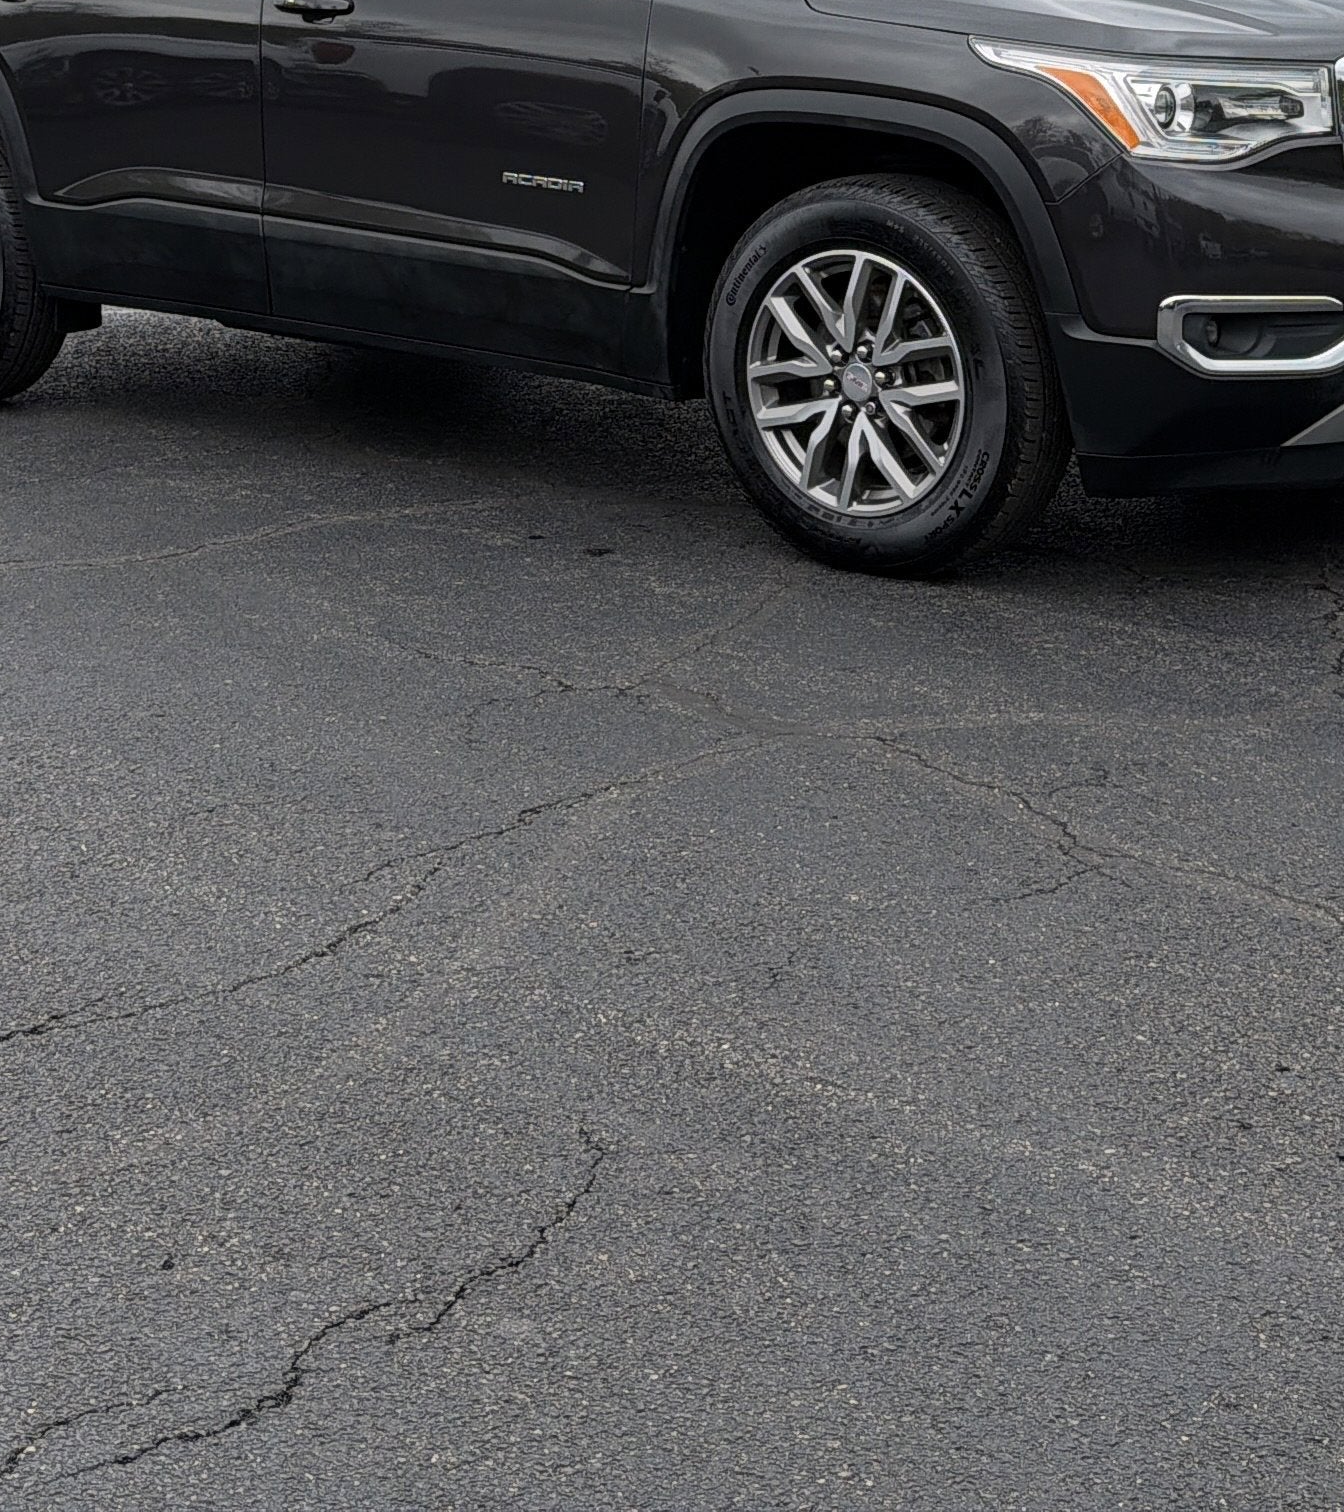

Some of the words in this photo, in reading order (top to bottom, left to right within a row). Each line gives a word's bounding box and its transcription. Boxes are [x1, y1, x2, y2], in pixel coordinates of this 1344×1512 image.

[502, 171, 584, 193] ACADIA
[726, 248, 763, 306] Continental
[969, 451, 990, 492] CROSS
